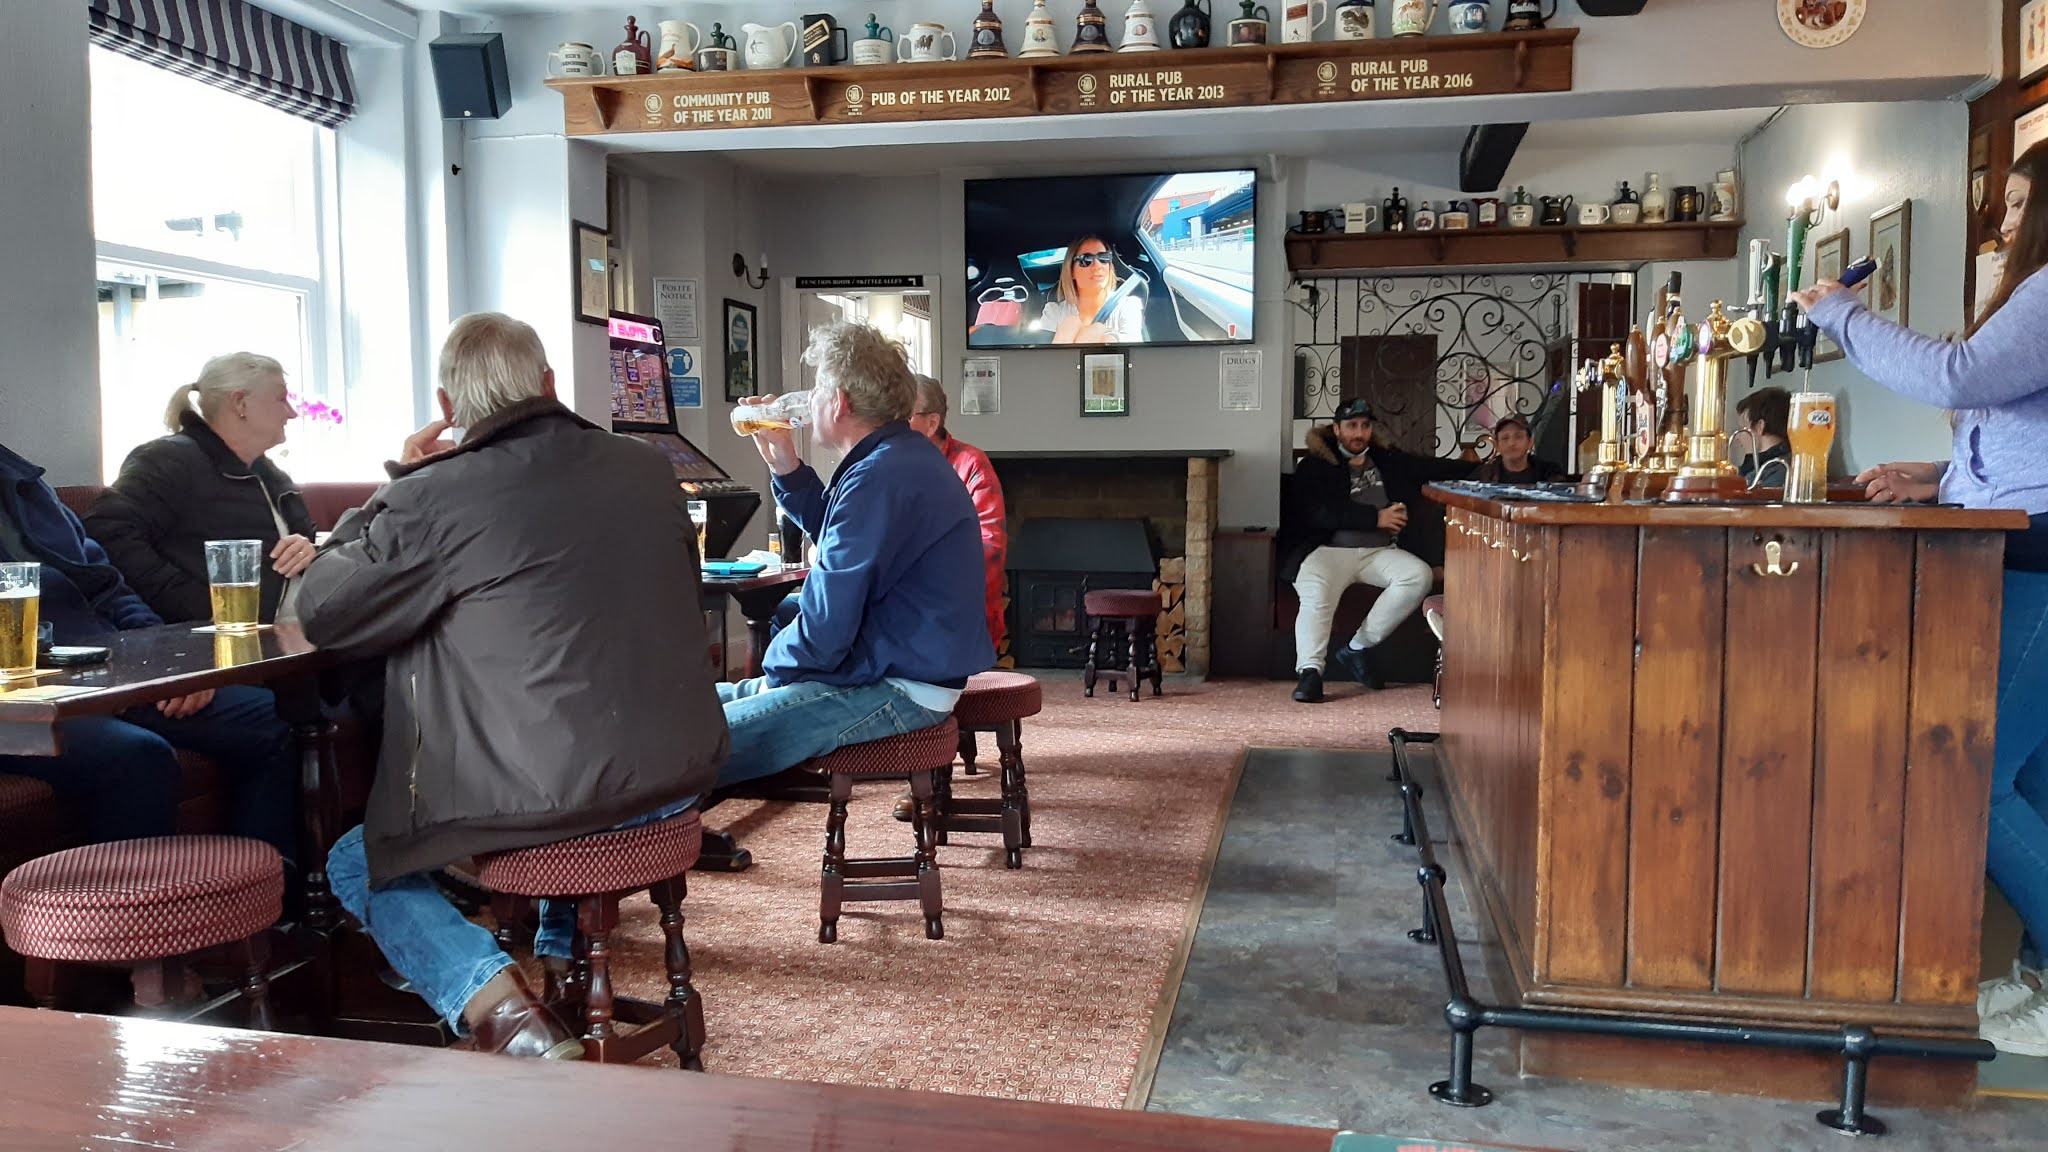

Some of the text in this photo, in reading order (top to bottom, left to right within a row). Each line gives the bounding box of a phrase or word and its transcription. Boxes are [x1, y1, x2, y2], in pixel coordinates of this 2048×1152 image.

[1351, 59, 1428, 76] RURAL PUB
[1109, 71, 1183, 88] RURAL PUB
[1351, 73, 1473, 93] OF THE YEAR 2016
[673, 91, 770, 108] COMMUNITY PUB
[871, 87, 1011, 106] PUB OF THE YEAR 2012
[1110, 85, 1225, 104] OF THE YEAR 2013
[673, 110, 689, 124] OF
[692, 109, 714, 123] THE
[717, 108, 748, 122] YEAR
[751, 107, 772, 120] 2011
[660, 292, 693, 300] NOTICE
[662, 283, 691, 292] POLITE
[1227, 357, 1256, 365] DRUGS
